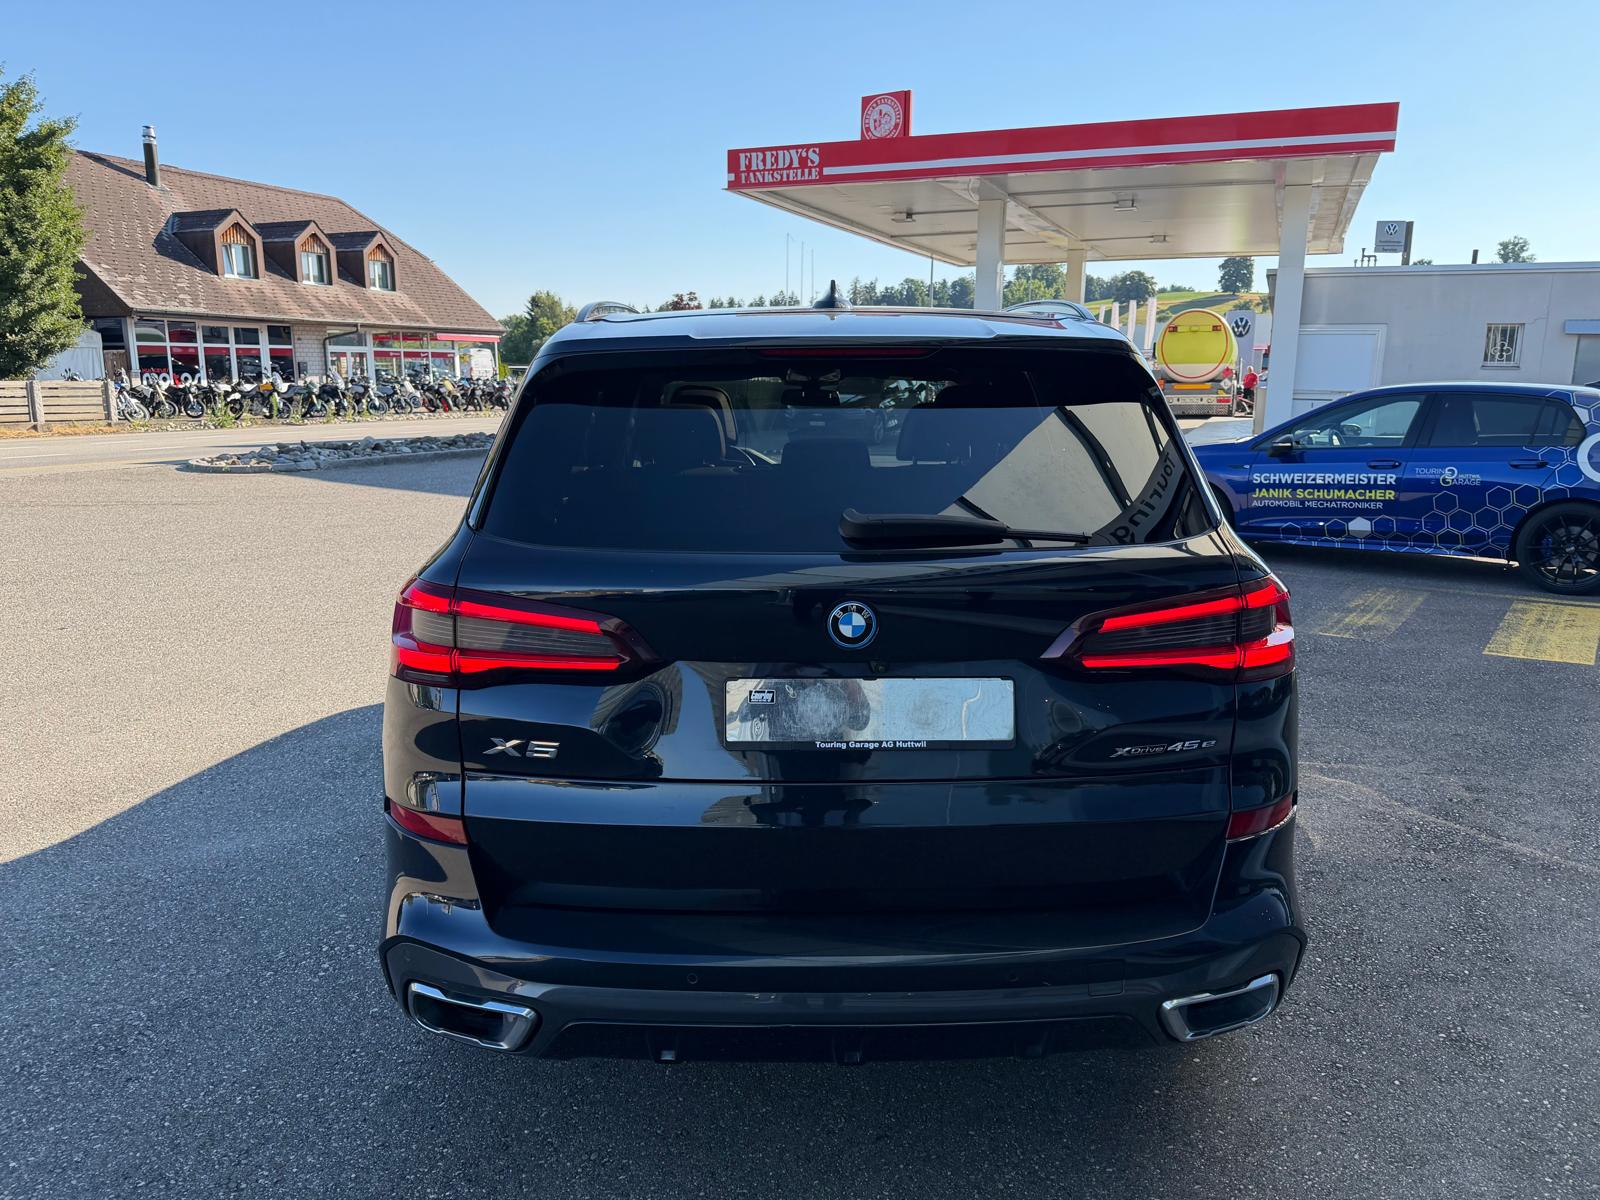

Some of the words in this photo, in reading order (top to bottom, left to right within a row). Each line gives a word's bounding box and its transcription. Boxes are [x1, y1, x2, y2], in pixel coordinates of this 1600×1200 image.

[739, 147, 820, 171] FREDY'S
[741, 167, 820, 184] TANKSTELLE
[1252, 473, 1397, 485] SCHWEIZERMEISTER
[1252, 488, 1293, 498] JANIK
[1296, 488, 1396, 500] SCHUMACHER
[1252, 500, 1303, 508] AUTOMOBIL
[1305, 500, 1384, 510] MECHATRONIKER
[834, 605, 871, 619] BMW
[482, 737, 561, 760] X5
[815, 741, 847, 750] Touring
[849, 741, 880, 750] Garage
[896, 740, 927, 748] Huttwil
